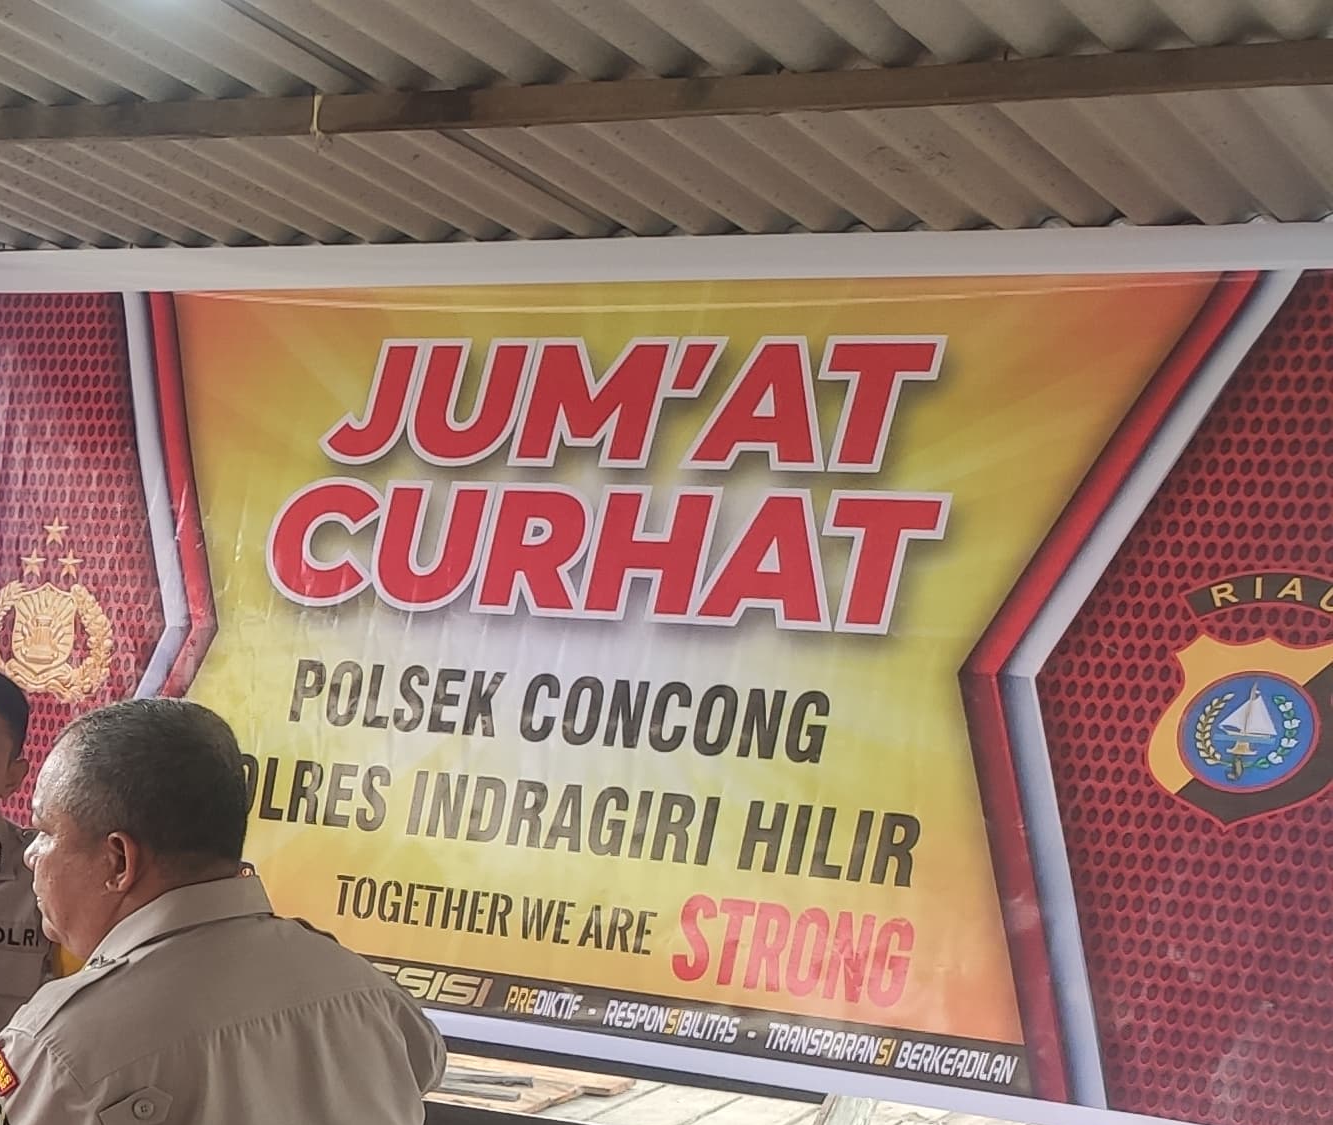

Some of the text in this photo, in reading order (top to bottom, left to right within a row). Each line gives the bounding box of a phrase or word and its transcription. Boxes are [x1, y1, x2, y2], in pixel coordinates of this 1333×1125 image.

[321, 337, 946, 471] JUM'AT
[266, 478, 951, 633] CURHAT
[288, 658, 831, 765] POLSEK CONCONG
[405, 770, 722, 866] INDRAGIRI
[736, 800, 922, 888] HILIR
[336, 874, 916, 1008] TOGETHER WE ARE STRONG
[505, 985, 585, 1017] PREDIKTIF
[602, 999, 741, 1044] RESPONSIBILITAS
[764, 1021, 897, 1068] TRANSPARANSI
[894, 1040, 1019, 1085] BERKEADILAN
